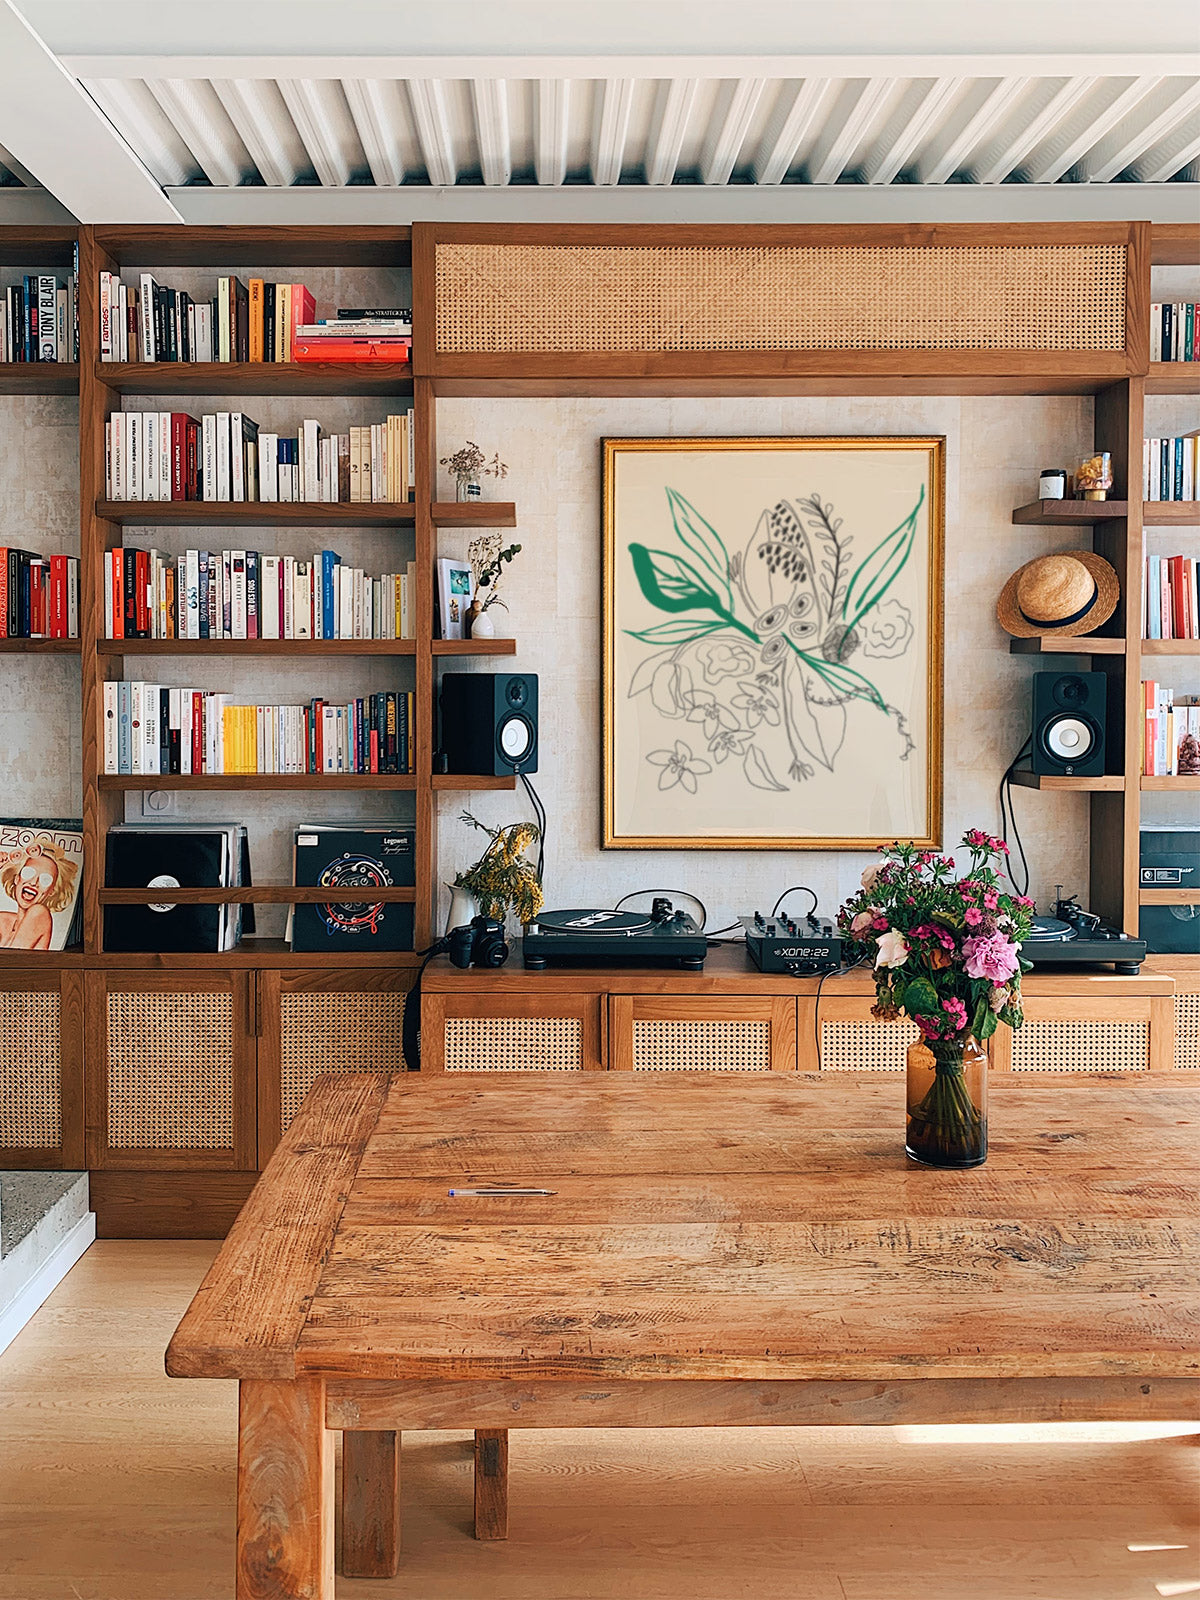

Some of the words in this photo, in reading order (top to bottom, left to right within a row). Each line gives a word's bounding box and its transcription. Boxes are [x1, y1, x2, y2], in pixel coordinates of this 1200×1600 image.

[40, 277, 55, 308] BLAIR
[40, 311, 55, 338] TONY
[101, 308, 109, 342] ramses
[247, 579, 256, 593] FOUS
[247, 593, 256, 604] DES
[387, 701, 396, 735] UNDERCOVER
[383, 837, 408, 845] Legowelt
[781, 947, 830, 957] xone:22
